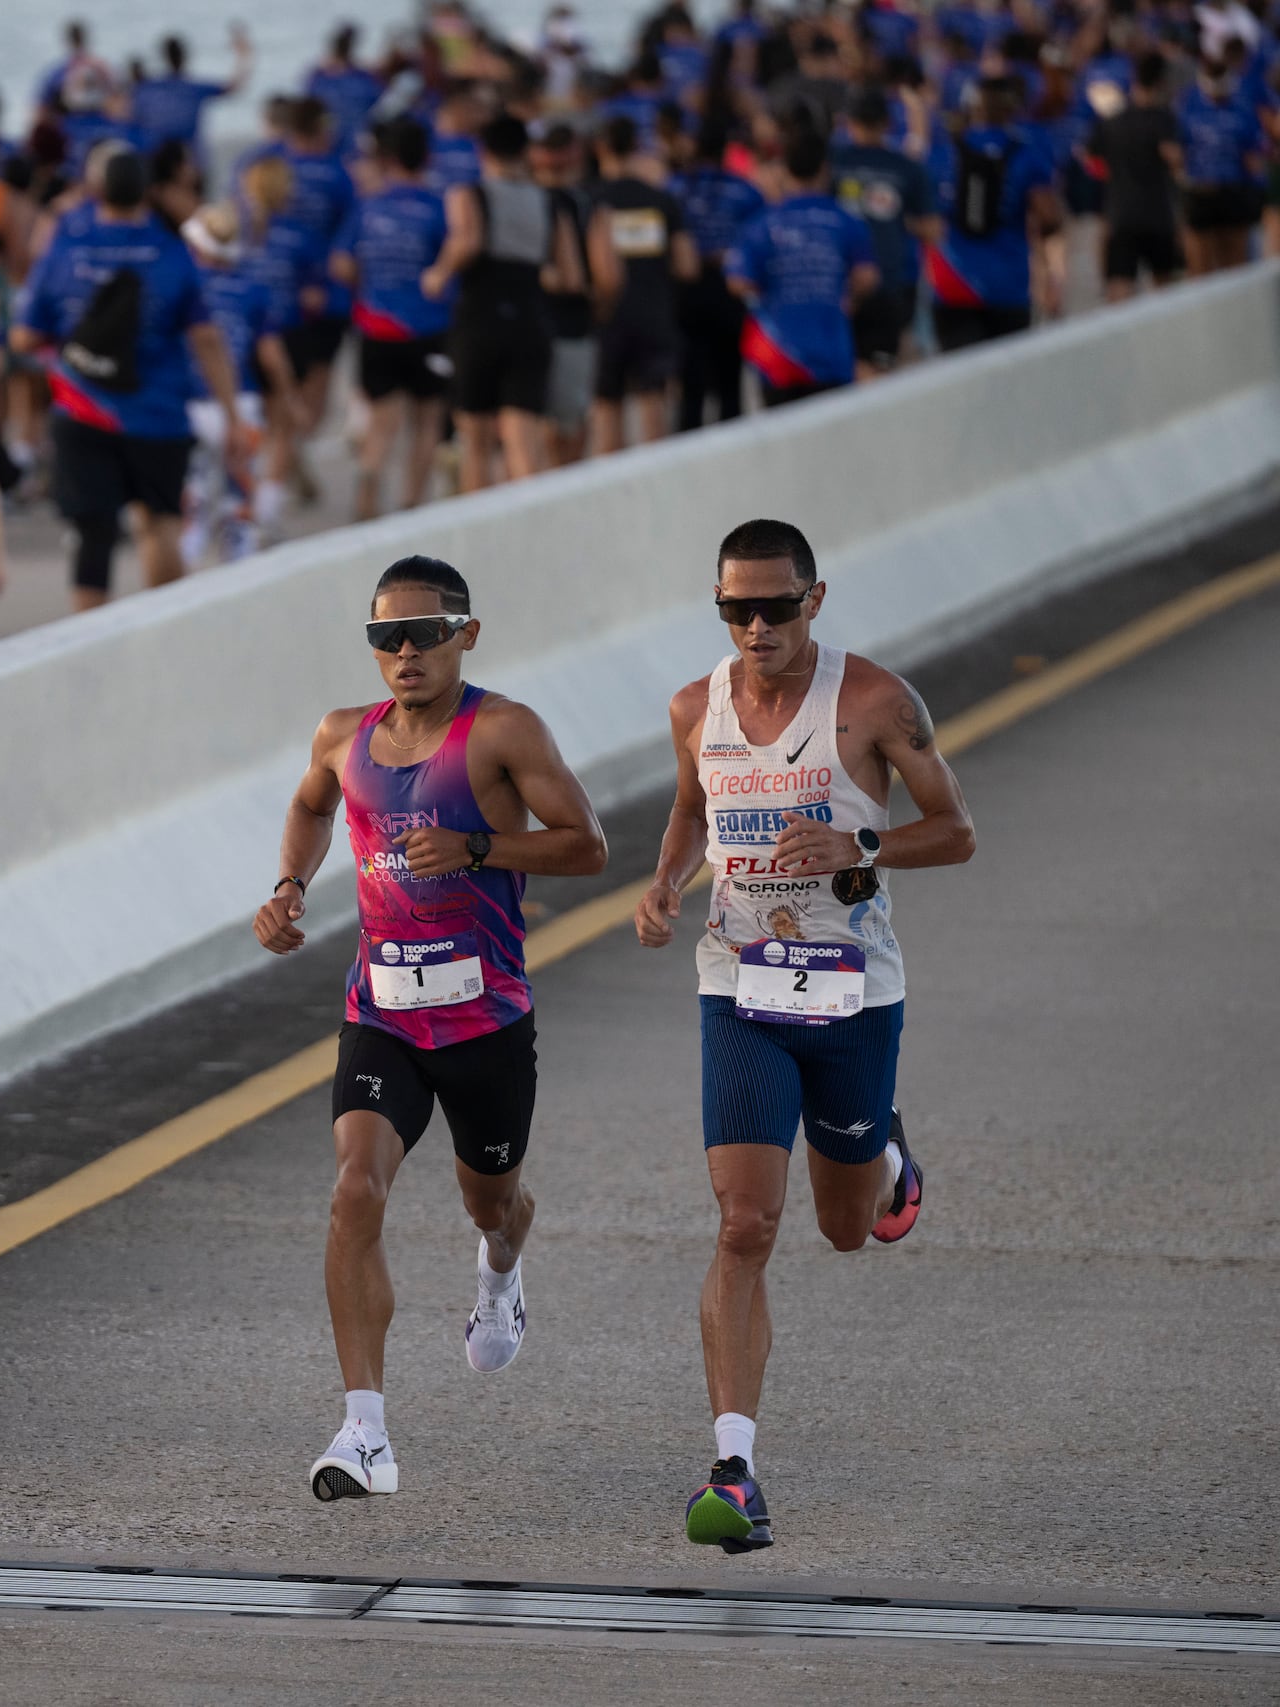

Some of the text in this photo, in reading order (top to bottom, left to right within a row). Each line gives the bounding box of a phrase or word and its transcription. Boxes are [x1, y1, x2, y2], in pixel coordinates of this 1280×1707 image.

[709, 765, 832, 797] Credicentro
[797, 789, 831, 804] coop
[715, 805, 833, 833] COMERIO
[718, 833, 756, 841] CASH
[373, 852, 410, 870] SAN
[748, 880, 820, 893] CRONO
[749, 890, 811, 899] EVENTOS
[402, 941, 455, 954] TEODORO
[788, 946, 843, 958] TEODORO
[403, 953, 423, 963] 10K
[788, 956, 809, 966] 10K
[412, 967, 425, 988] 1
[793, 970, 808, 993] 2
[747, 1010, 754, 1018] 2
